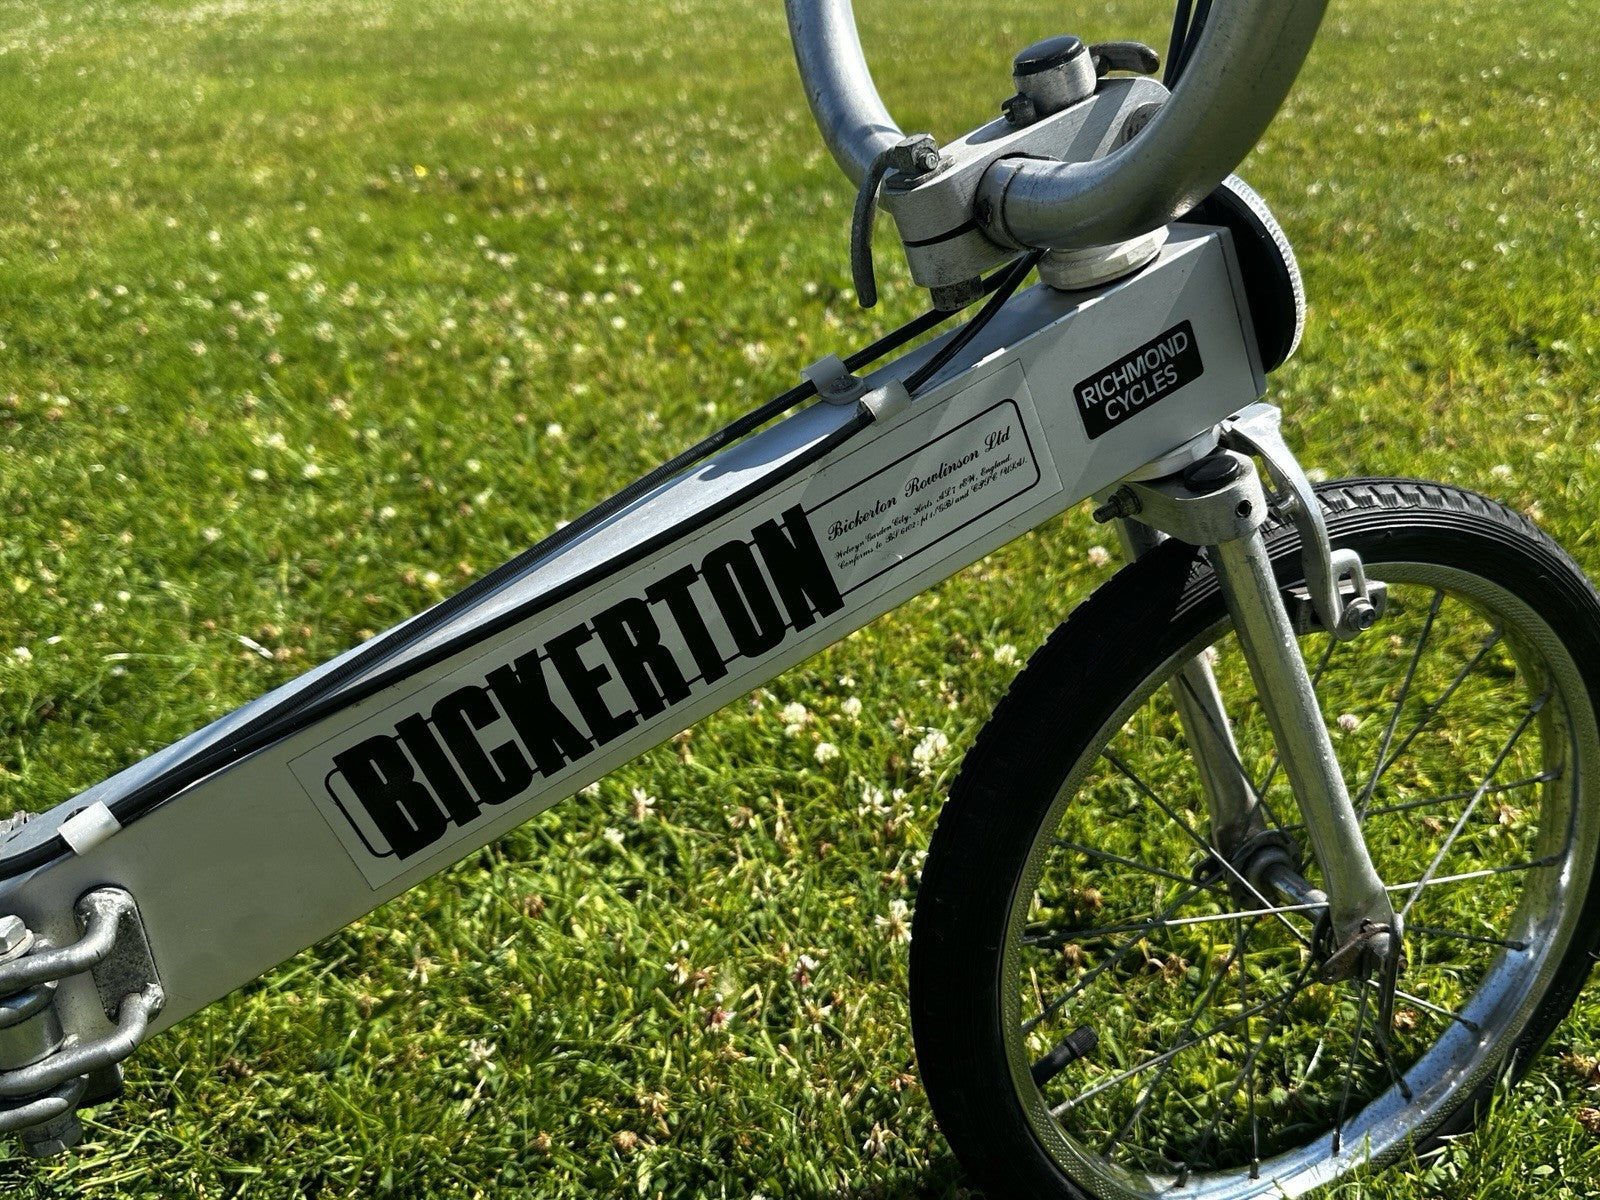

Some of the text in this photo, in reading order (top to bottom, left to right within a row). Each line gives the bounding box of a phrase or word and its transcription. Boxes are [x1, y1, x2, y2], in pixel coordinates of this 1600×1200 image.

[1081, 331, 1188, 409] RICHMOND
[1105, 364, 1178, 420] CYCLES
[828, 425, 1011, 541] Bickerton Rowlinson Ltd
[838, 547, 874, 569] Conforms
[865, 525, 892, 542] Garden
[332, 503, 845, 861] BICKERTON
